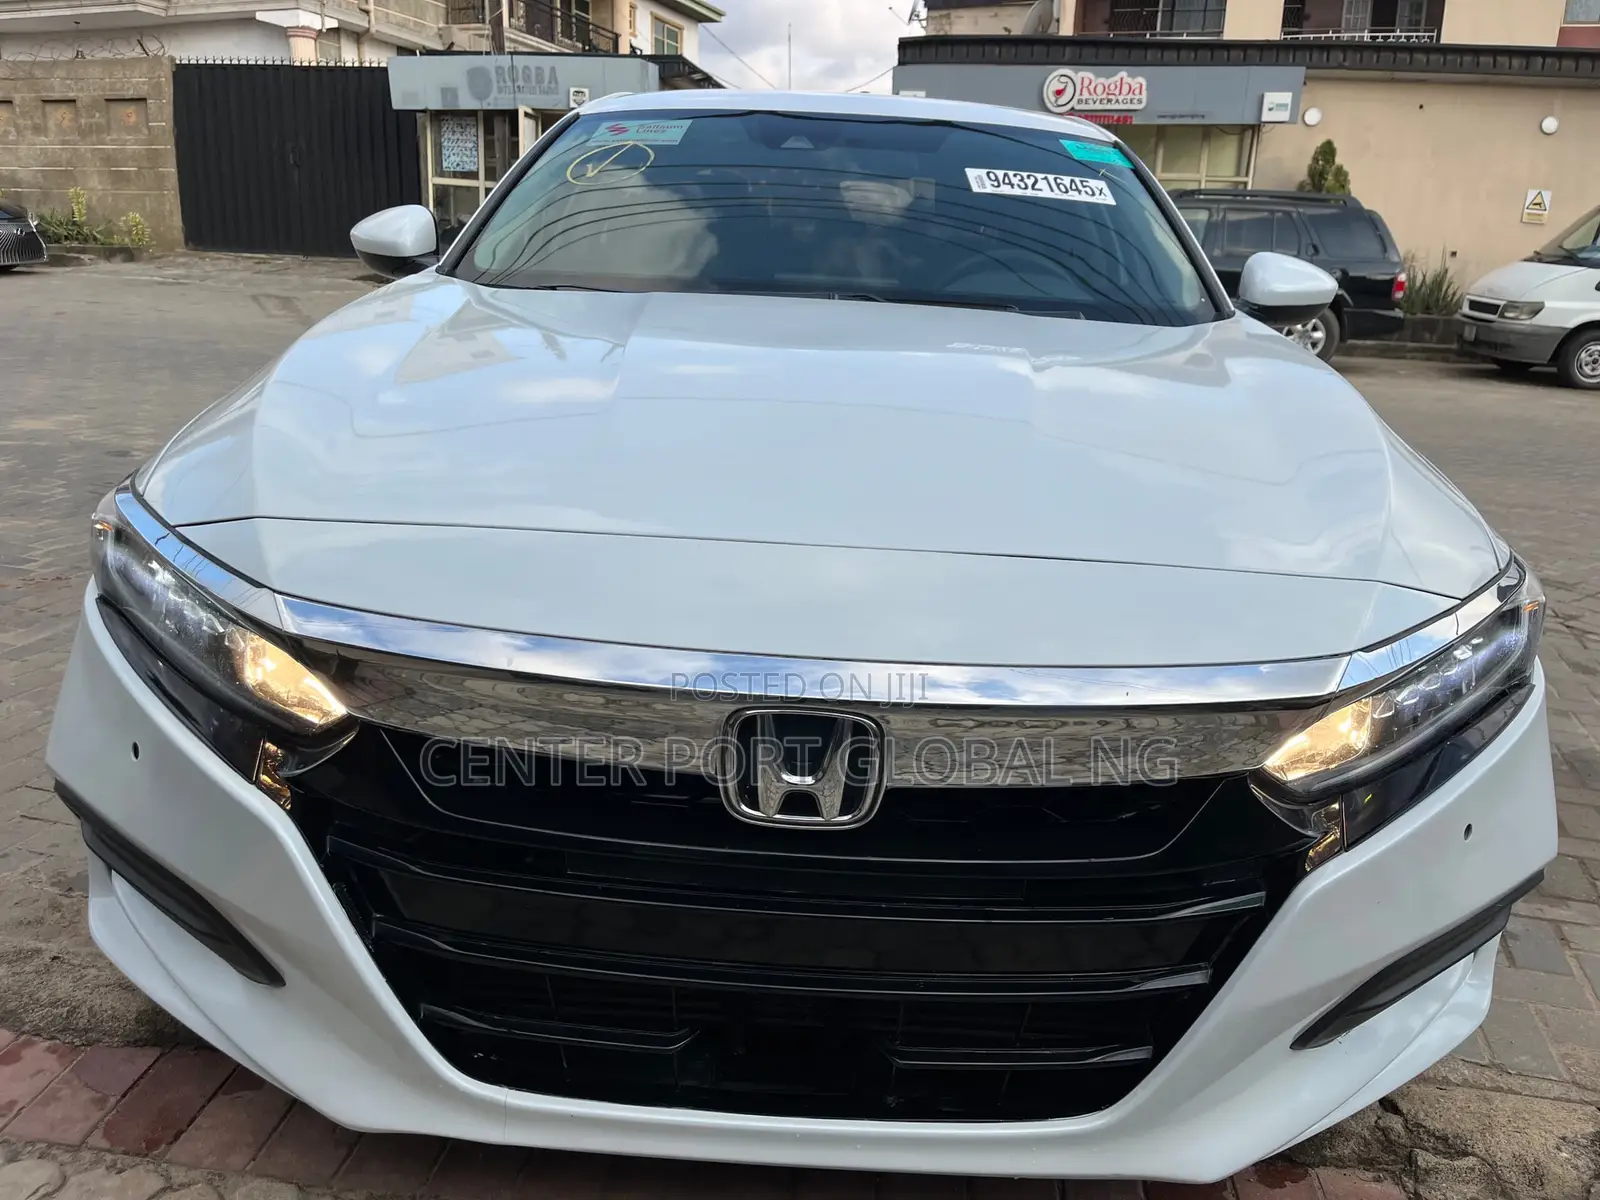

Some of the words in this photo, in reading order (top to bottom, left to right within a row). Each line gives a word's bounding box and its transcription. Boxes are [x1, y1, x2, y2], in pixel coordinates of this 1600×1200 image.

[494, 65, 559, 85] ROGBA
[1080, 76, 1144, 97] Rogba
[1077, 97, 1143, 105] BEVERAGES
